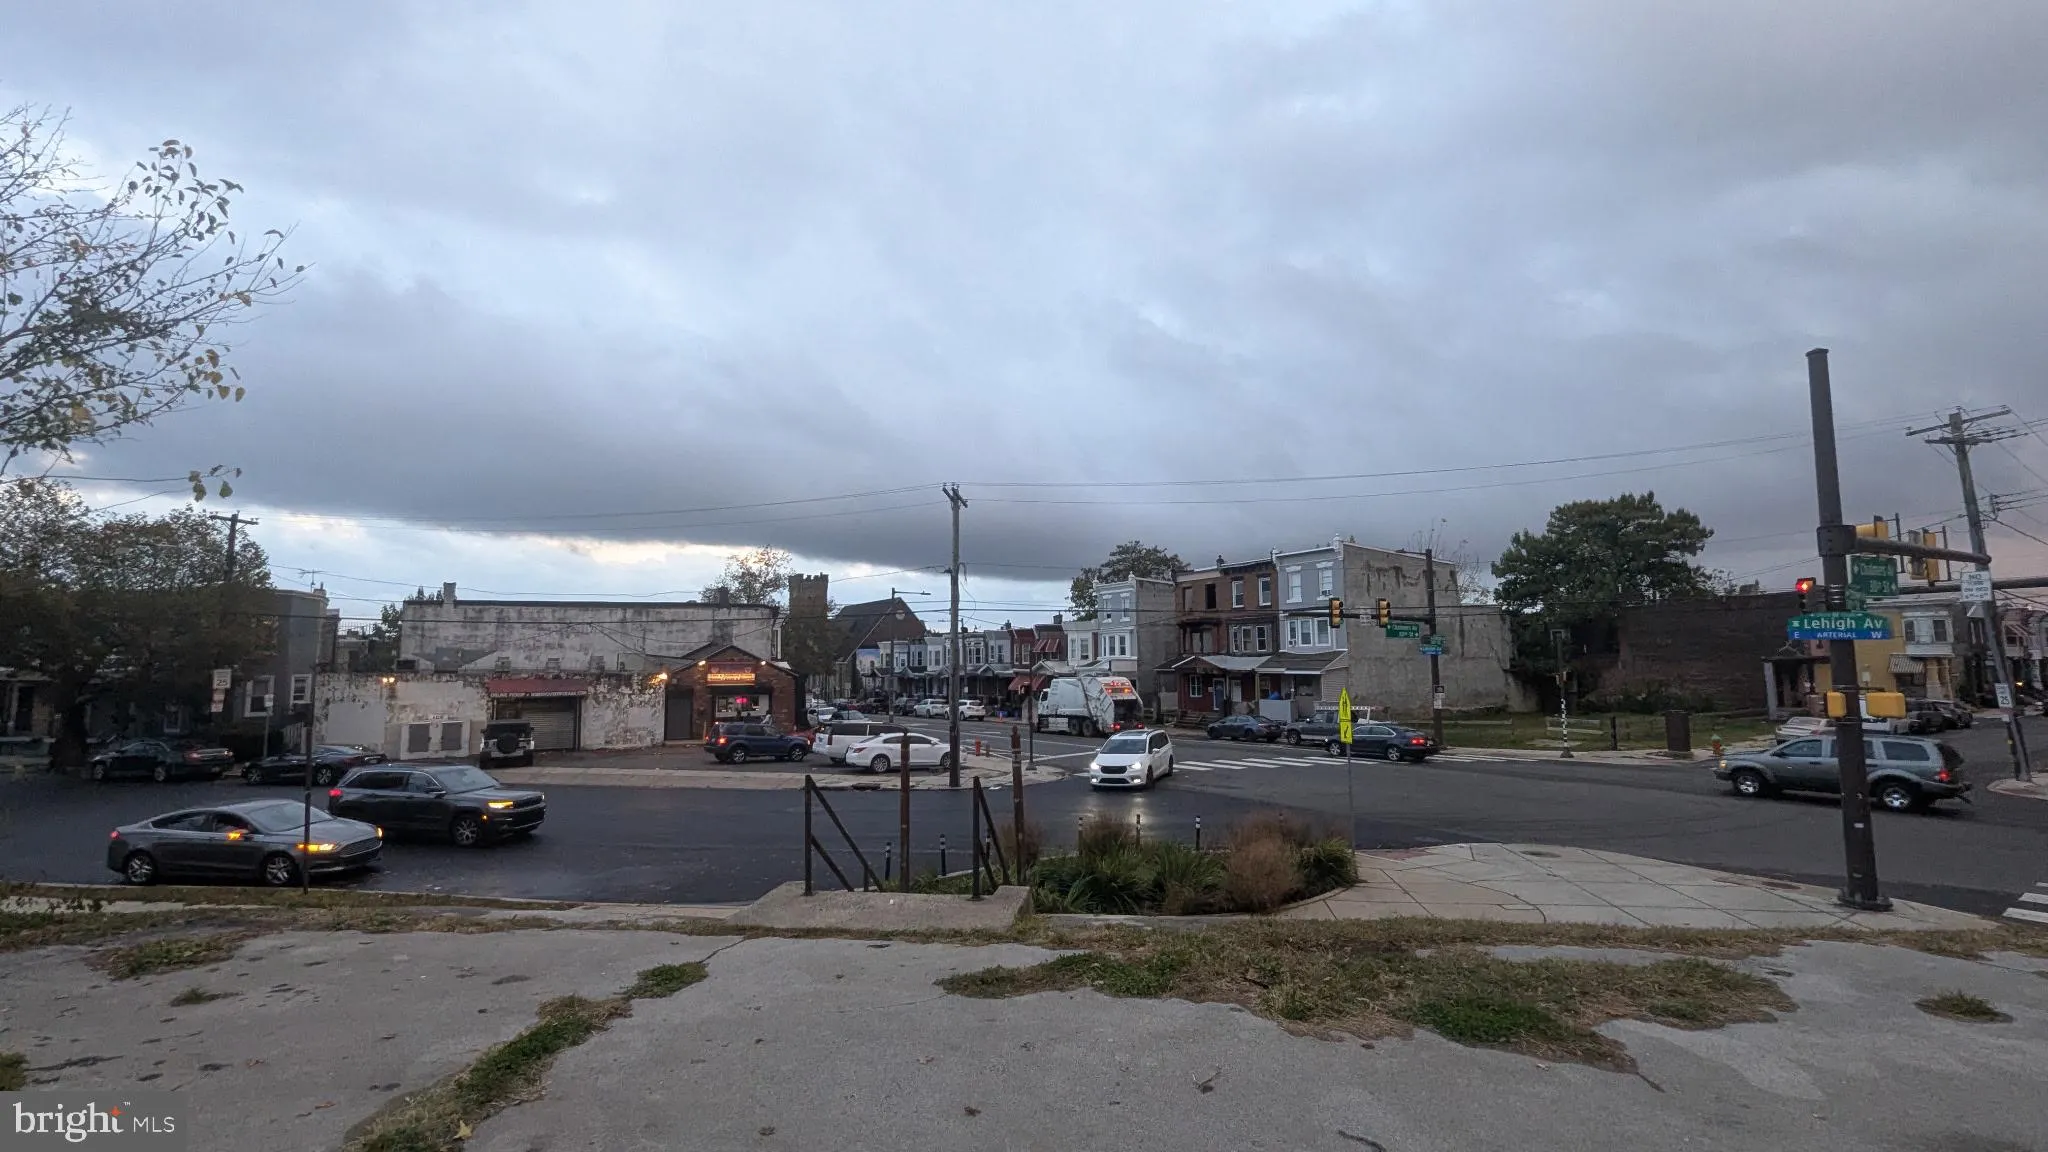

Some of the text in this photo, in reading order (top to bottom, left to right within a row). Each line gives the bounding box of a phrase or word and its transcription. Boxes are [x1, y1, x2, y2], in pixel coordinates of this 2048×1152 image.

[1804, 618, 1883, 630] Lehigh Av
[2000, 695, 2009, 705] 25
